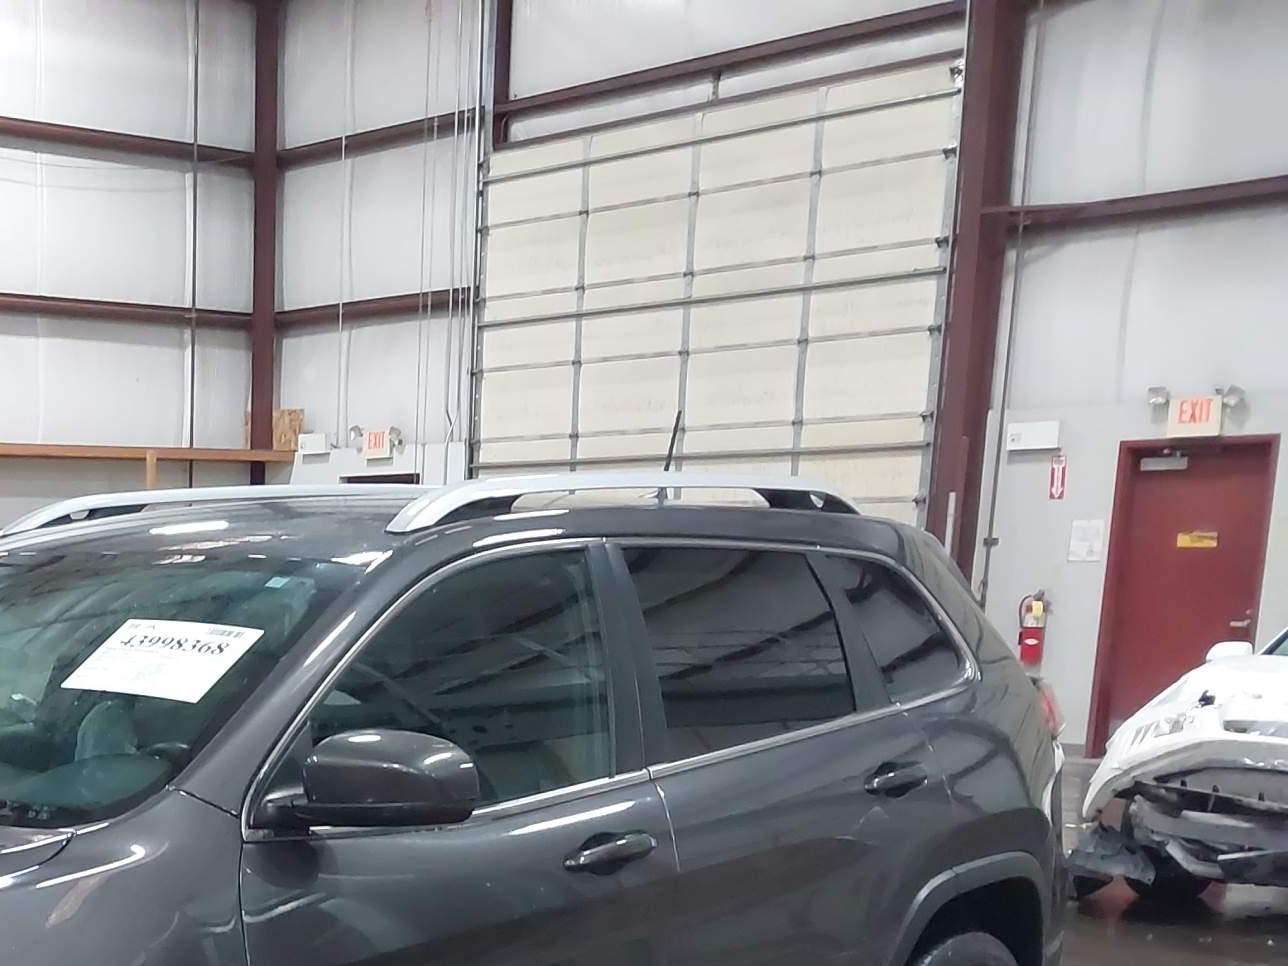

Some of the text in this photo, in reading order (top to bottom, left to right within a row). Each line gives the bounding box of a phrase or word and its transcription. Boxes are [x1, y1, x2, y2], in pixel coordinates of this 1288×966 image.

[1177, 398, 1213, 424] EXIT
[368, 431, 385, 449] EXIT
[120, 634, 230, 655] 43998368
